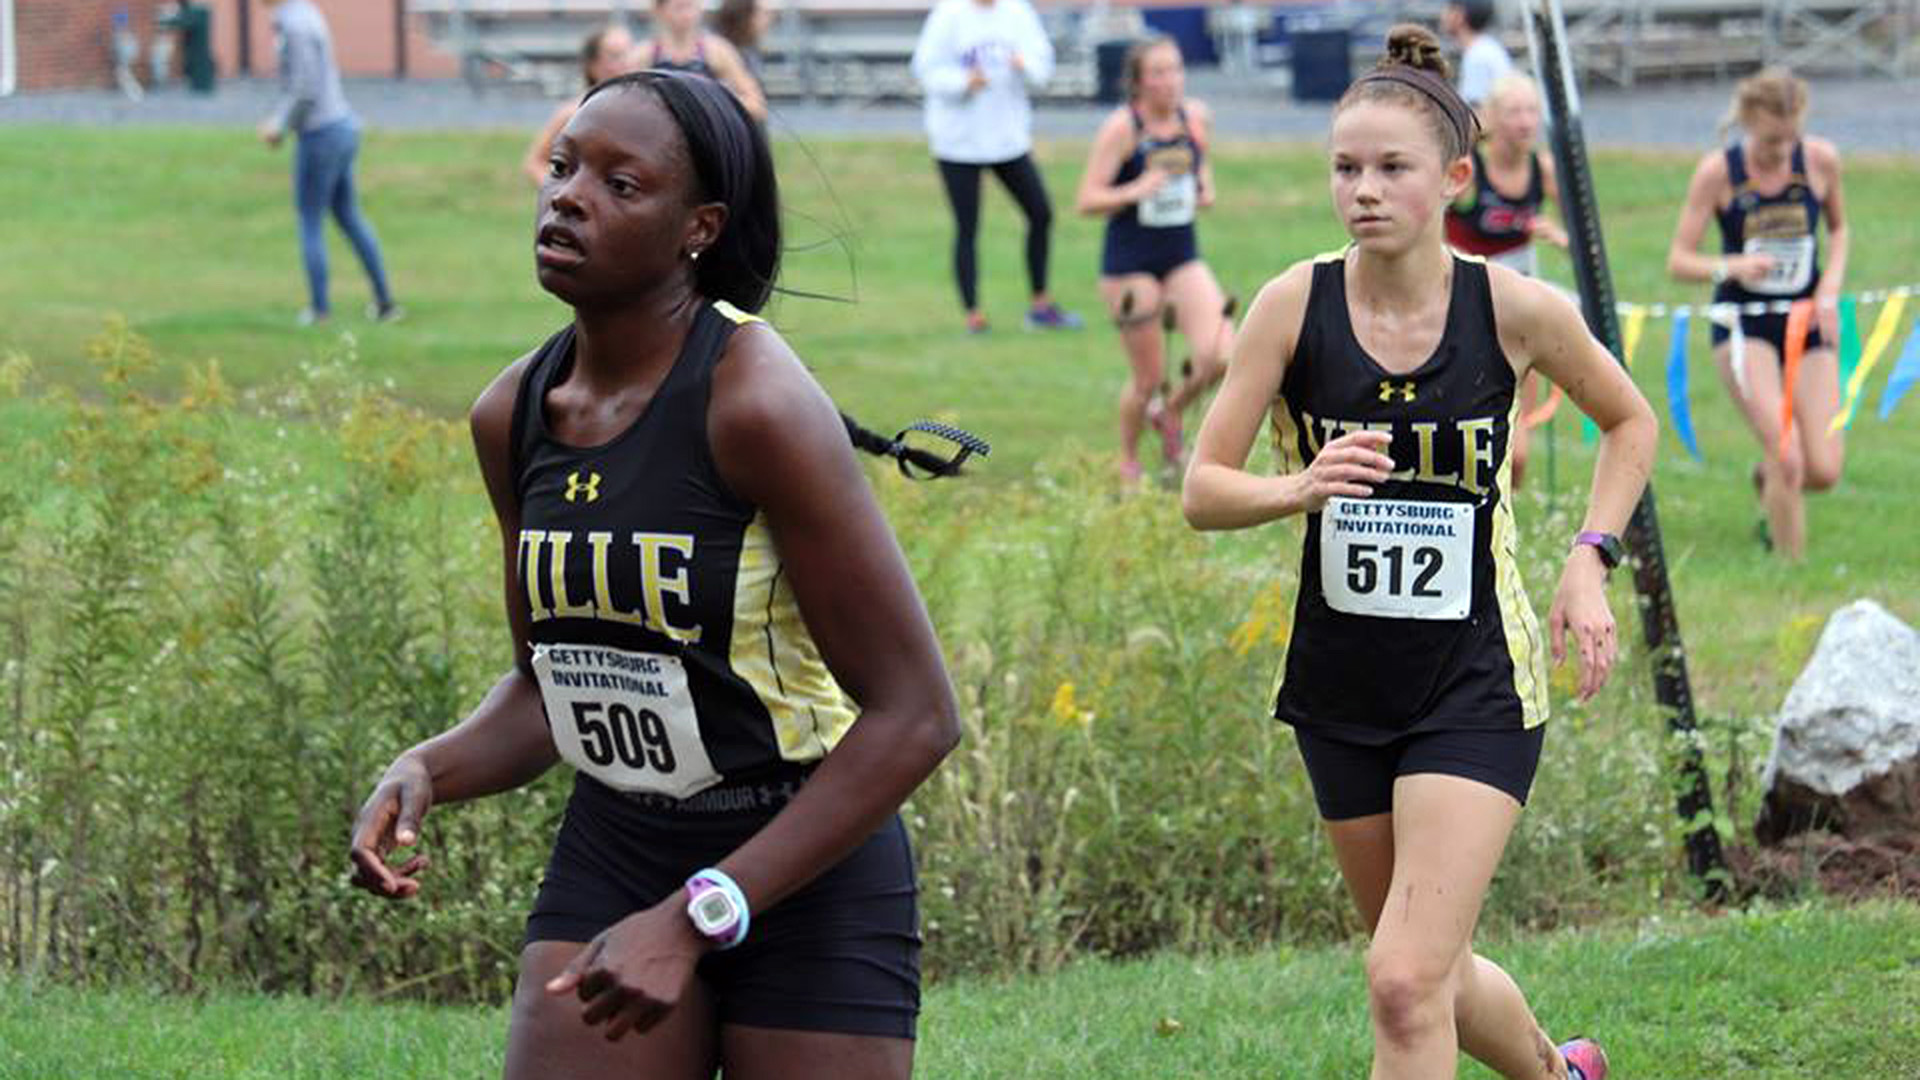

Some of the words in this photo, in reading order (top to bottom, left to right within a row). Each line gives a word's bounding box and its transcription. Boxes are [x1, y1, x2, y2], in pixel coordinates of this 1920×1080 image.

[1340, 502, 1454, 519] GETTYSBURG
[1335, 519, 1457, 537] INVITATIONAL
[1346, 543, 1444, 597] 512
[517, 529, 703, 644] ILLE
[549, 649, 661, 674] GETTYSBURG
[551, 670, 669, 697] INVITATIONAL
[571, 701, 677, 774] 509
